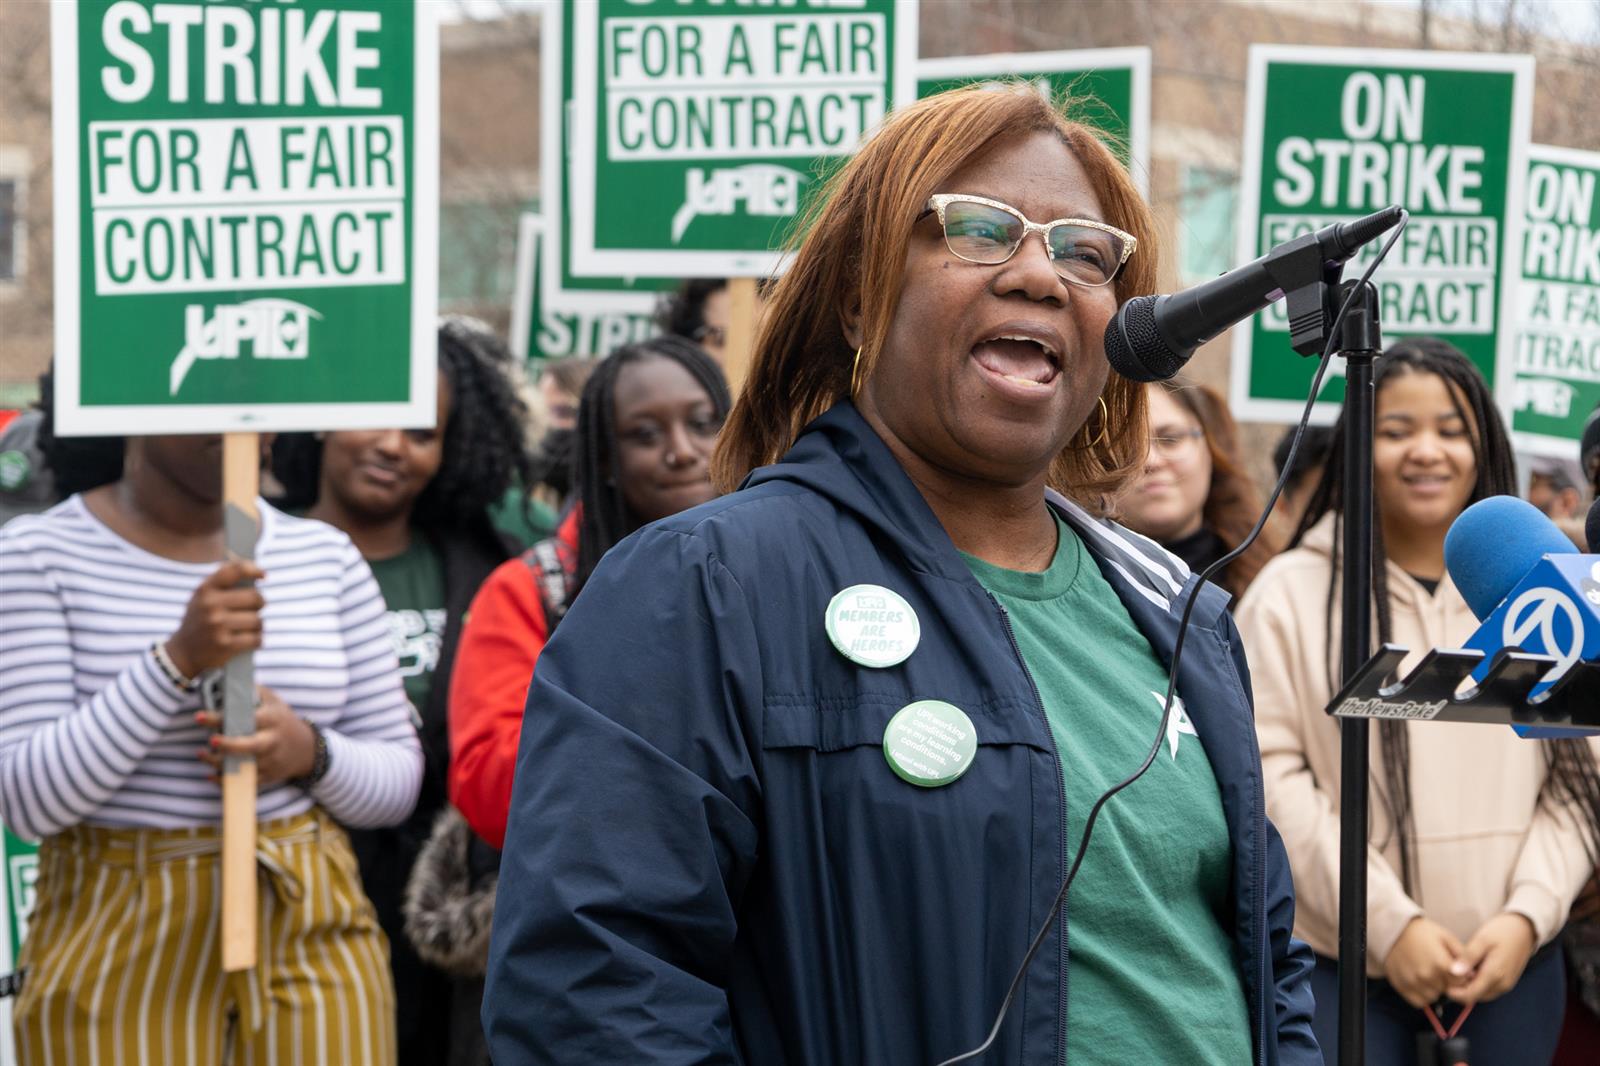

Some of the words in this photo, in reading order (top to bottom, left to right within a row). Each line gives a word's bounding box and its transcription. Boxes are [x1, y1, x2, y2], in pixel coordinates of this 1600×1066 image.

[101, 1, 382, 108] STRIKE
[611, 25, 704, 78] FOR
[724, 23, 754, 75] A
[773, 21, 878, 74] FAIR
[616, 93, 875, 151] CONTRACT
[1342, 72, 1426, 142] ON
[96, 127, 202, 194] FOR
[224, 127, 259, 191] A
[279, 124, 395, 189] FAIR
[1275, 137, 1484, 213] STRIKE
[1527, 164, 1596, 227] ON
[104, 211, 394, 284] CONTRACT
[1402, 223, 1489, 268] FAIR
[1564, 287, 1600, 326] FA
[838, 610, 905, 623] MEMBERS
[850, 638, 905, 652] HEROES
[859, 624, 888, 637] ARE
